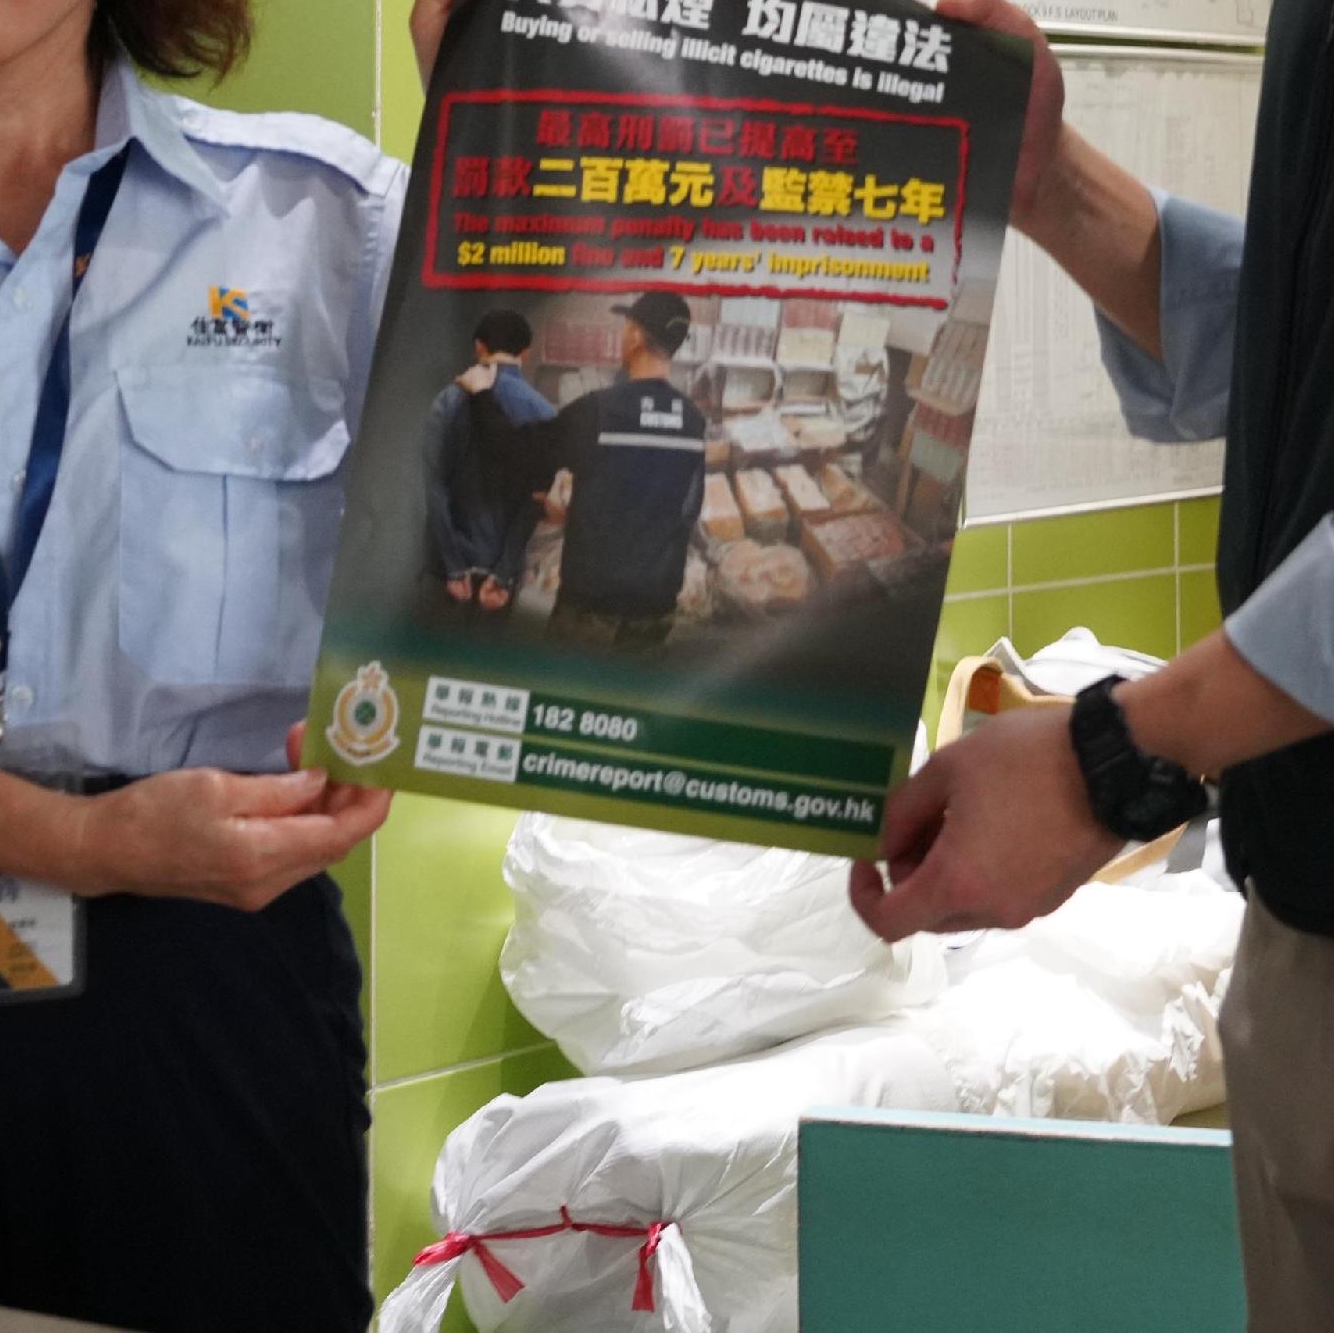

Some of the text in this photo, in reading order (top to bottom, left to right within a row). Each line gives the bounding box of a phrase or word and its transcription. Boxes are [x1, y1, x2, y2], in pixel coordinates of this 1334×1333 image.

[501, 9, 945, 103] Buying or selling illicit cigarettes is illegal
[453, 154, 946, 225] 罰款二百萬元及監禁七年
[454, 214, 489, 234] The
[610, 217, 696, 243] penalty
[701, 218, 744, 241] has
[749, 218, 806, 244] been
[811, 222, 885, 248] raised
[890, 228, 914, 251] to
[919, 235, 936, 253] a
[457, 241, 486, 266] $2
[489, 241, 566, 266] million
[669, 245, 686, 269] 7
[767, 252, 931, 284] imprisonment
[533, 704, 638, 742] 182 8080
[522, 751, 877, 822] crimereport@customs.gov.hk
